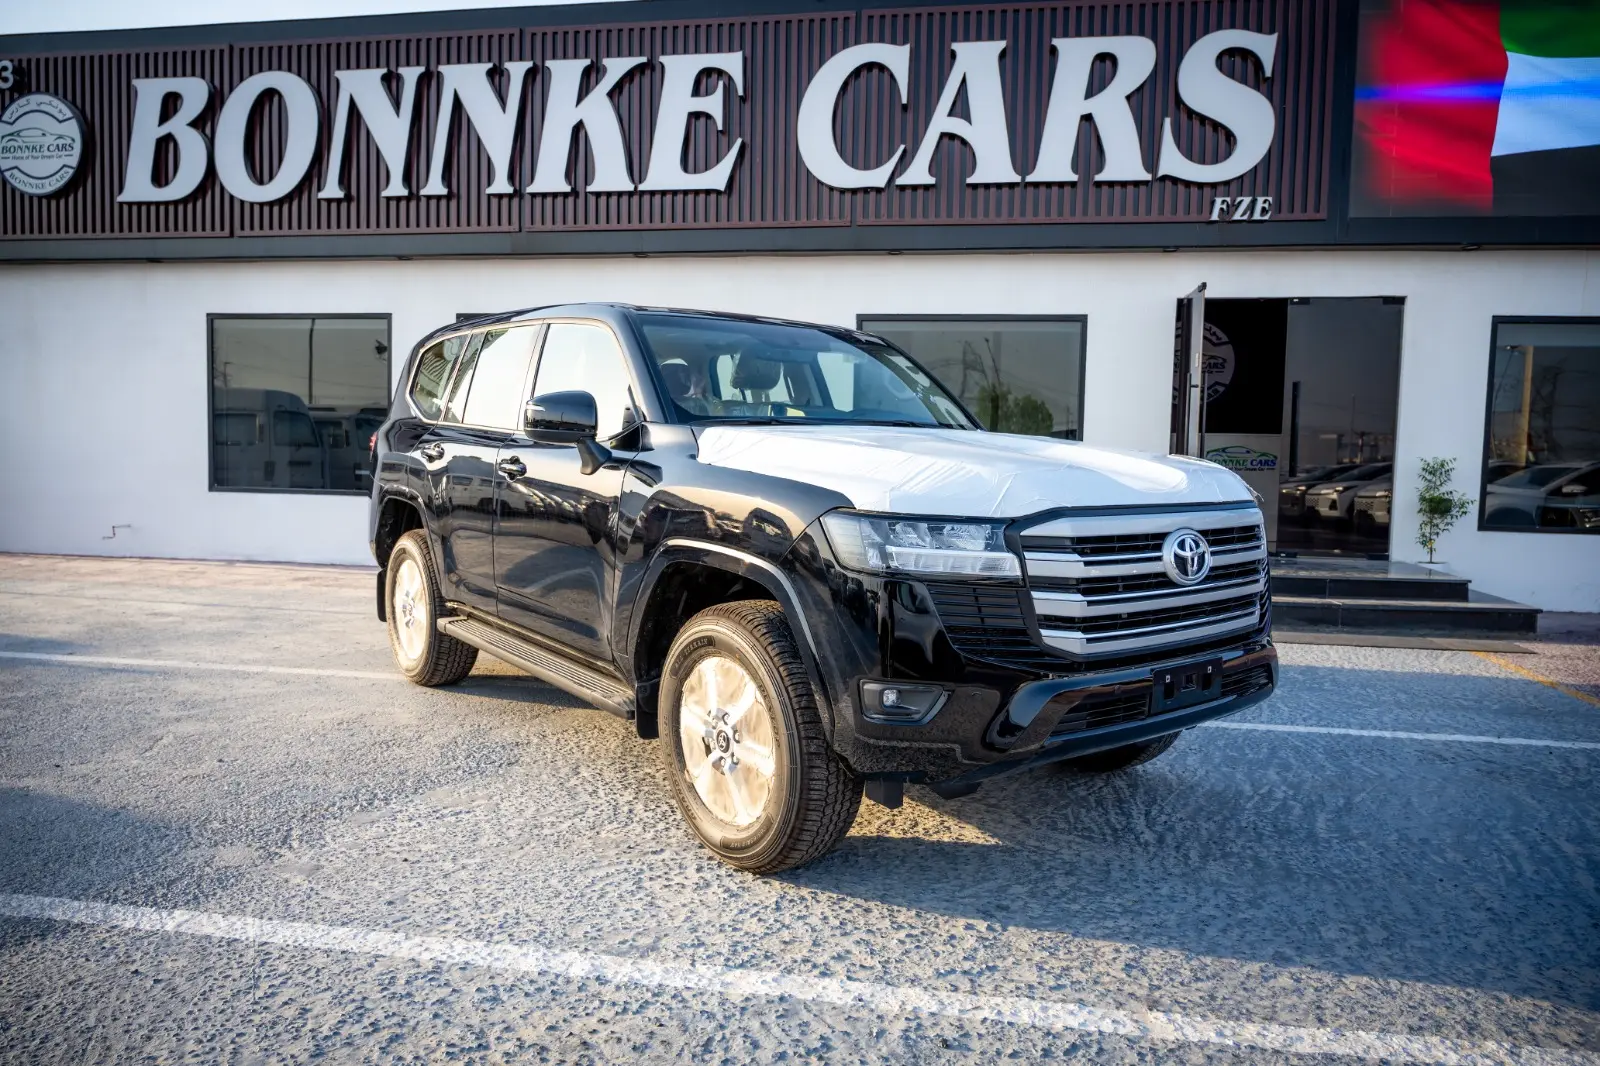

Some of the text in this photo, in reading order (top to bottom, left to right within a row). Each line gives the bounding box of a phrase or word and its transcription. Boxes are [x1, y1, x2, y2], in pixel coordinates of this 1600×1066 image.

[117, 29, 1279, 204] BONNKE CARS
[1, 143, 74, 154] BONNKE CARS
[9, 169, 70, 190] BONNKE CARS
[1210, 196, 1273, 221] FZE
[1250, 459, 1277, 467] CARS
